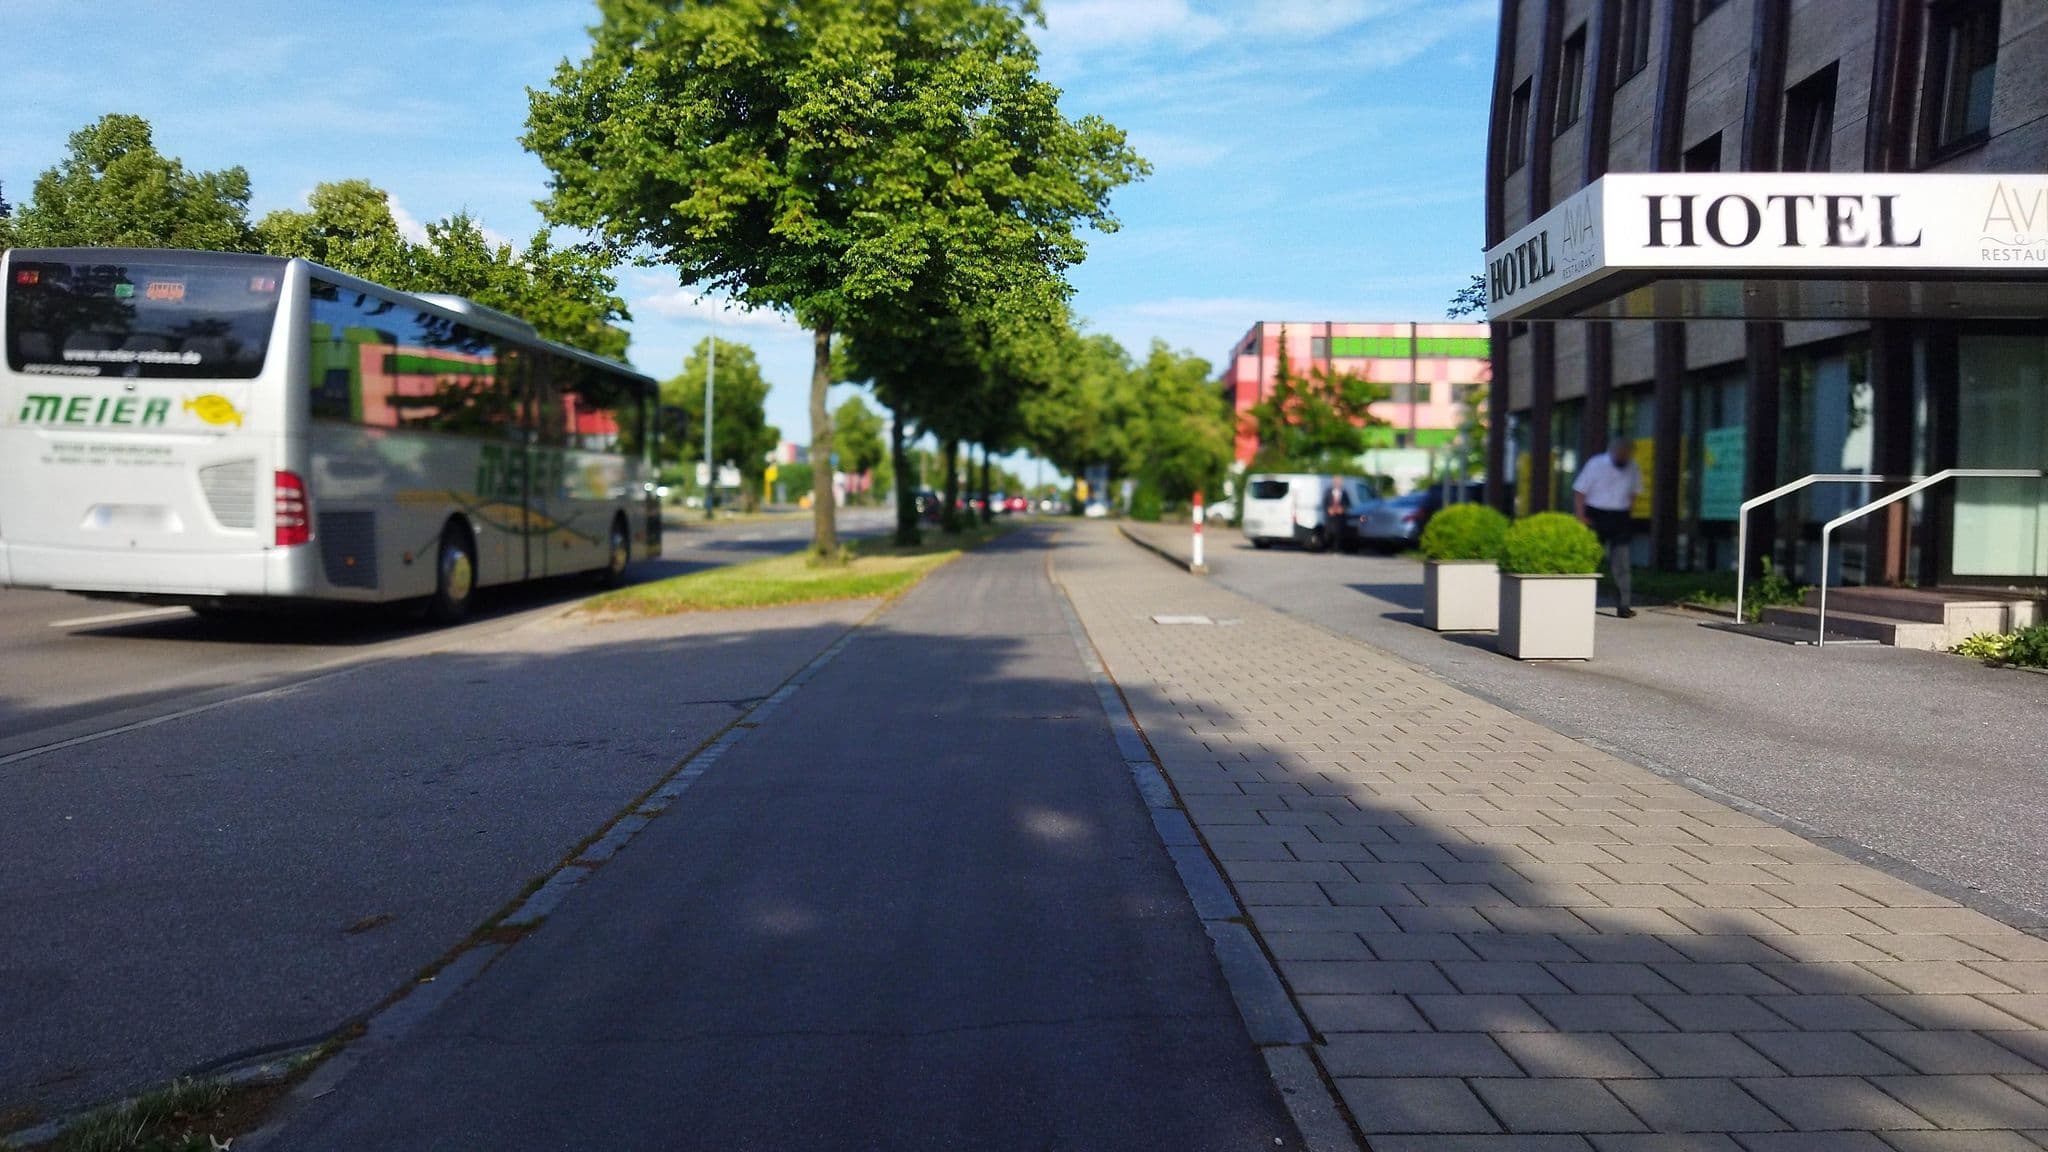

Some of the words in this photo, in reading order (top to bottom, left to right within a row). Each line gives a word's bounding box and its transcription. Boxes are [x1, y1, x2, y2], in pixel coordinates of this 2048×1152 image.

[1641, 194, 1923, 249] HOTEL
[1489, 230, 1556, 303] HOTEL
[19, 394, 174, 426] MEIER
